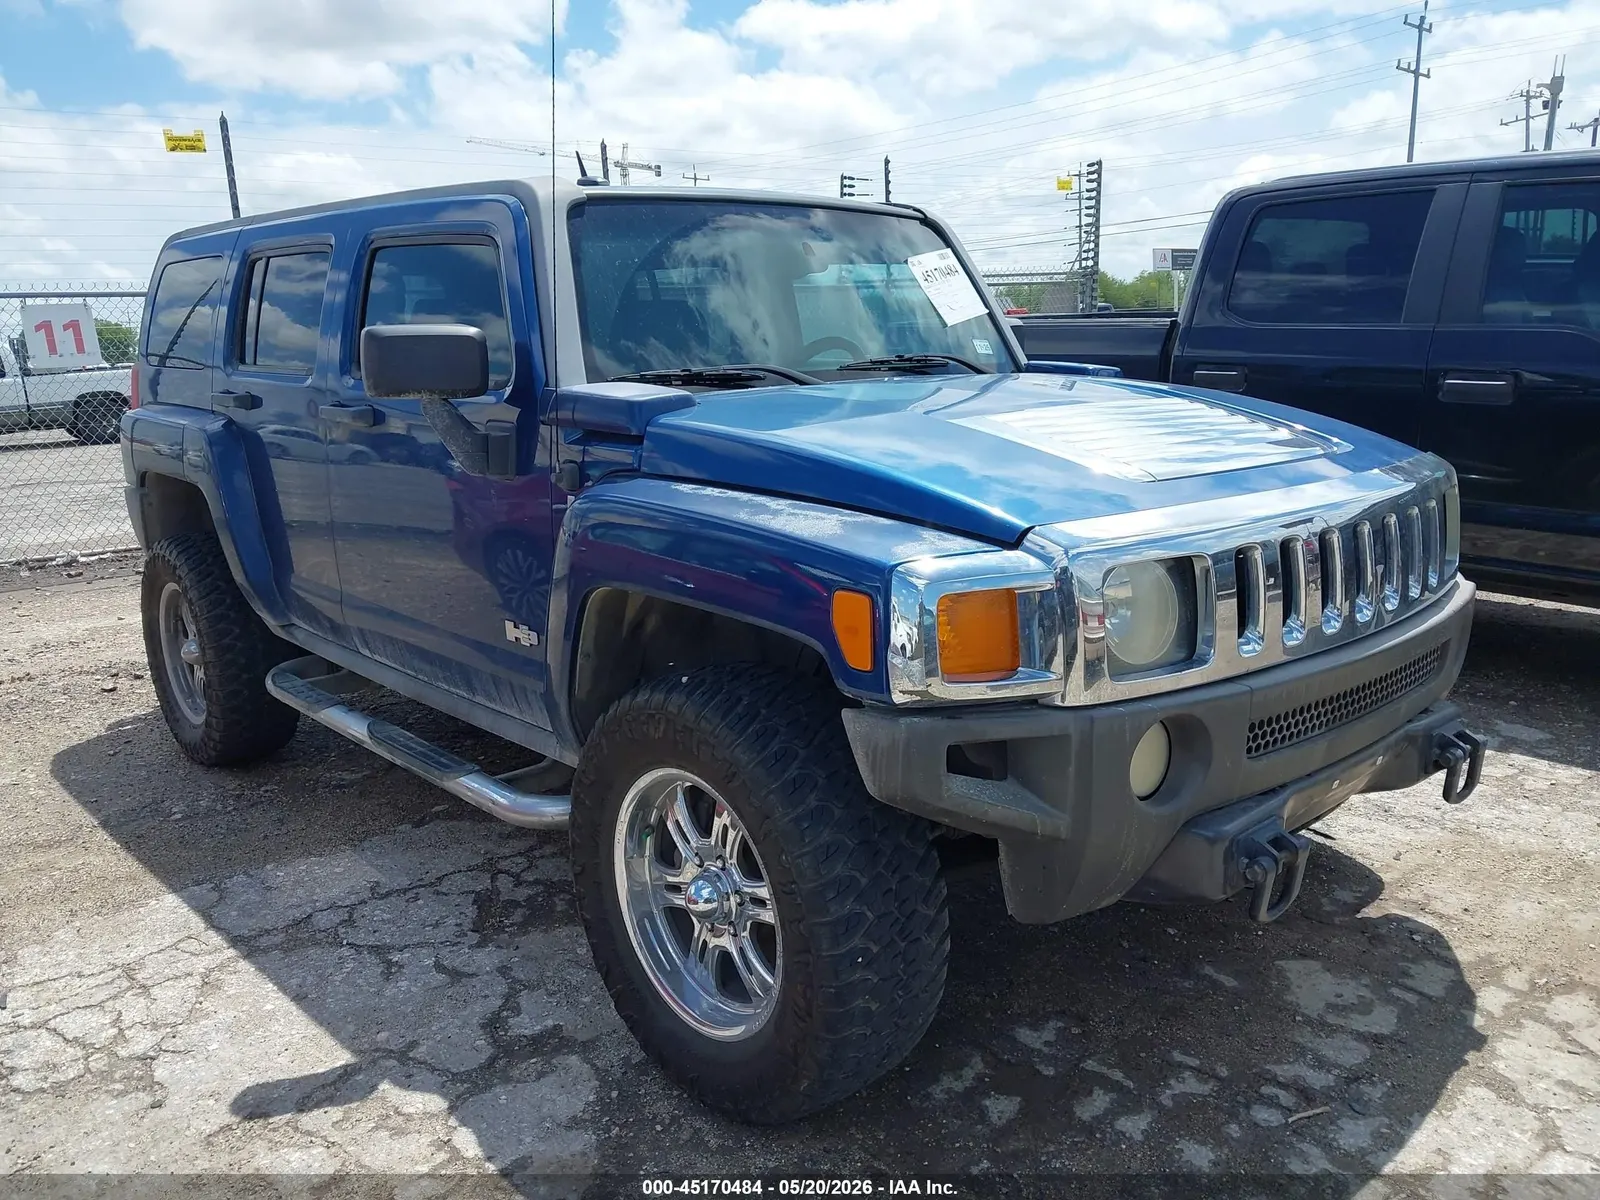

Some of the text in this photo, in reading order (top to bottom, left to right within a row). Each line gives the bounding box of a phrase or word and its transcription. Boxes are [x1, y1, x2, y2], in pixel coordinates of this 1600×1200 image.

[922, 264, 960, 284] 45170484
[34, 319, 86, 356] 11
[504, 620, 539, 647] H3
